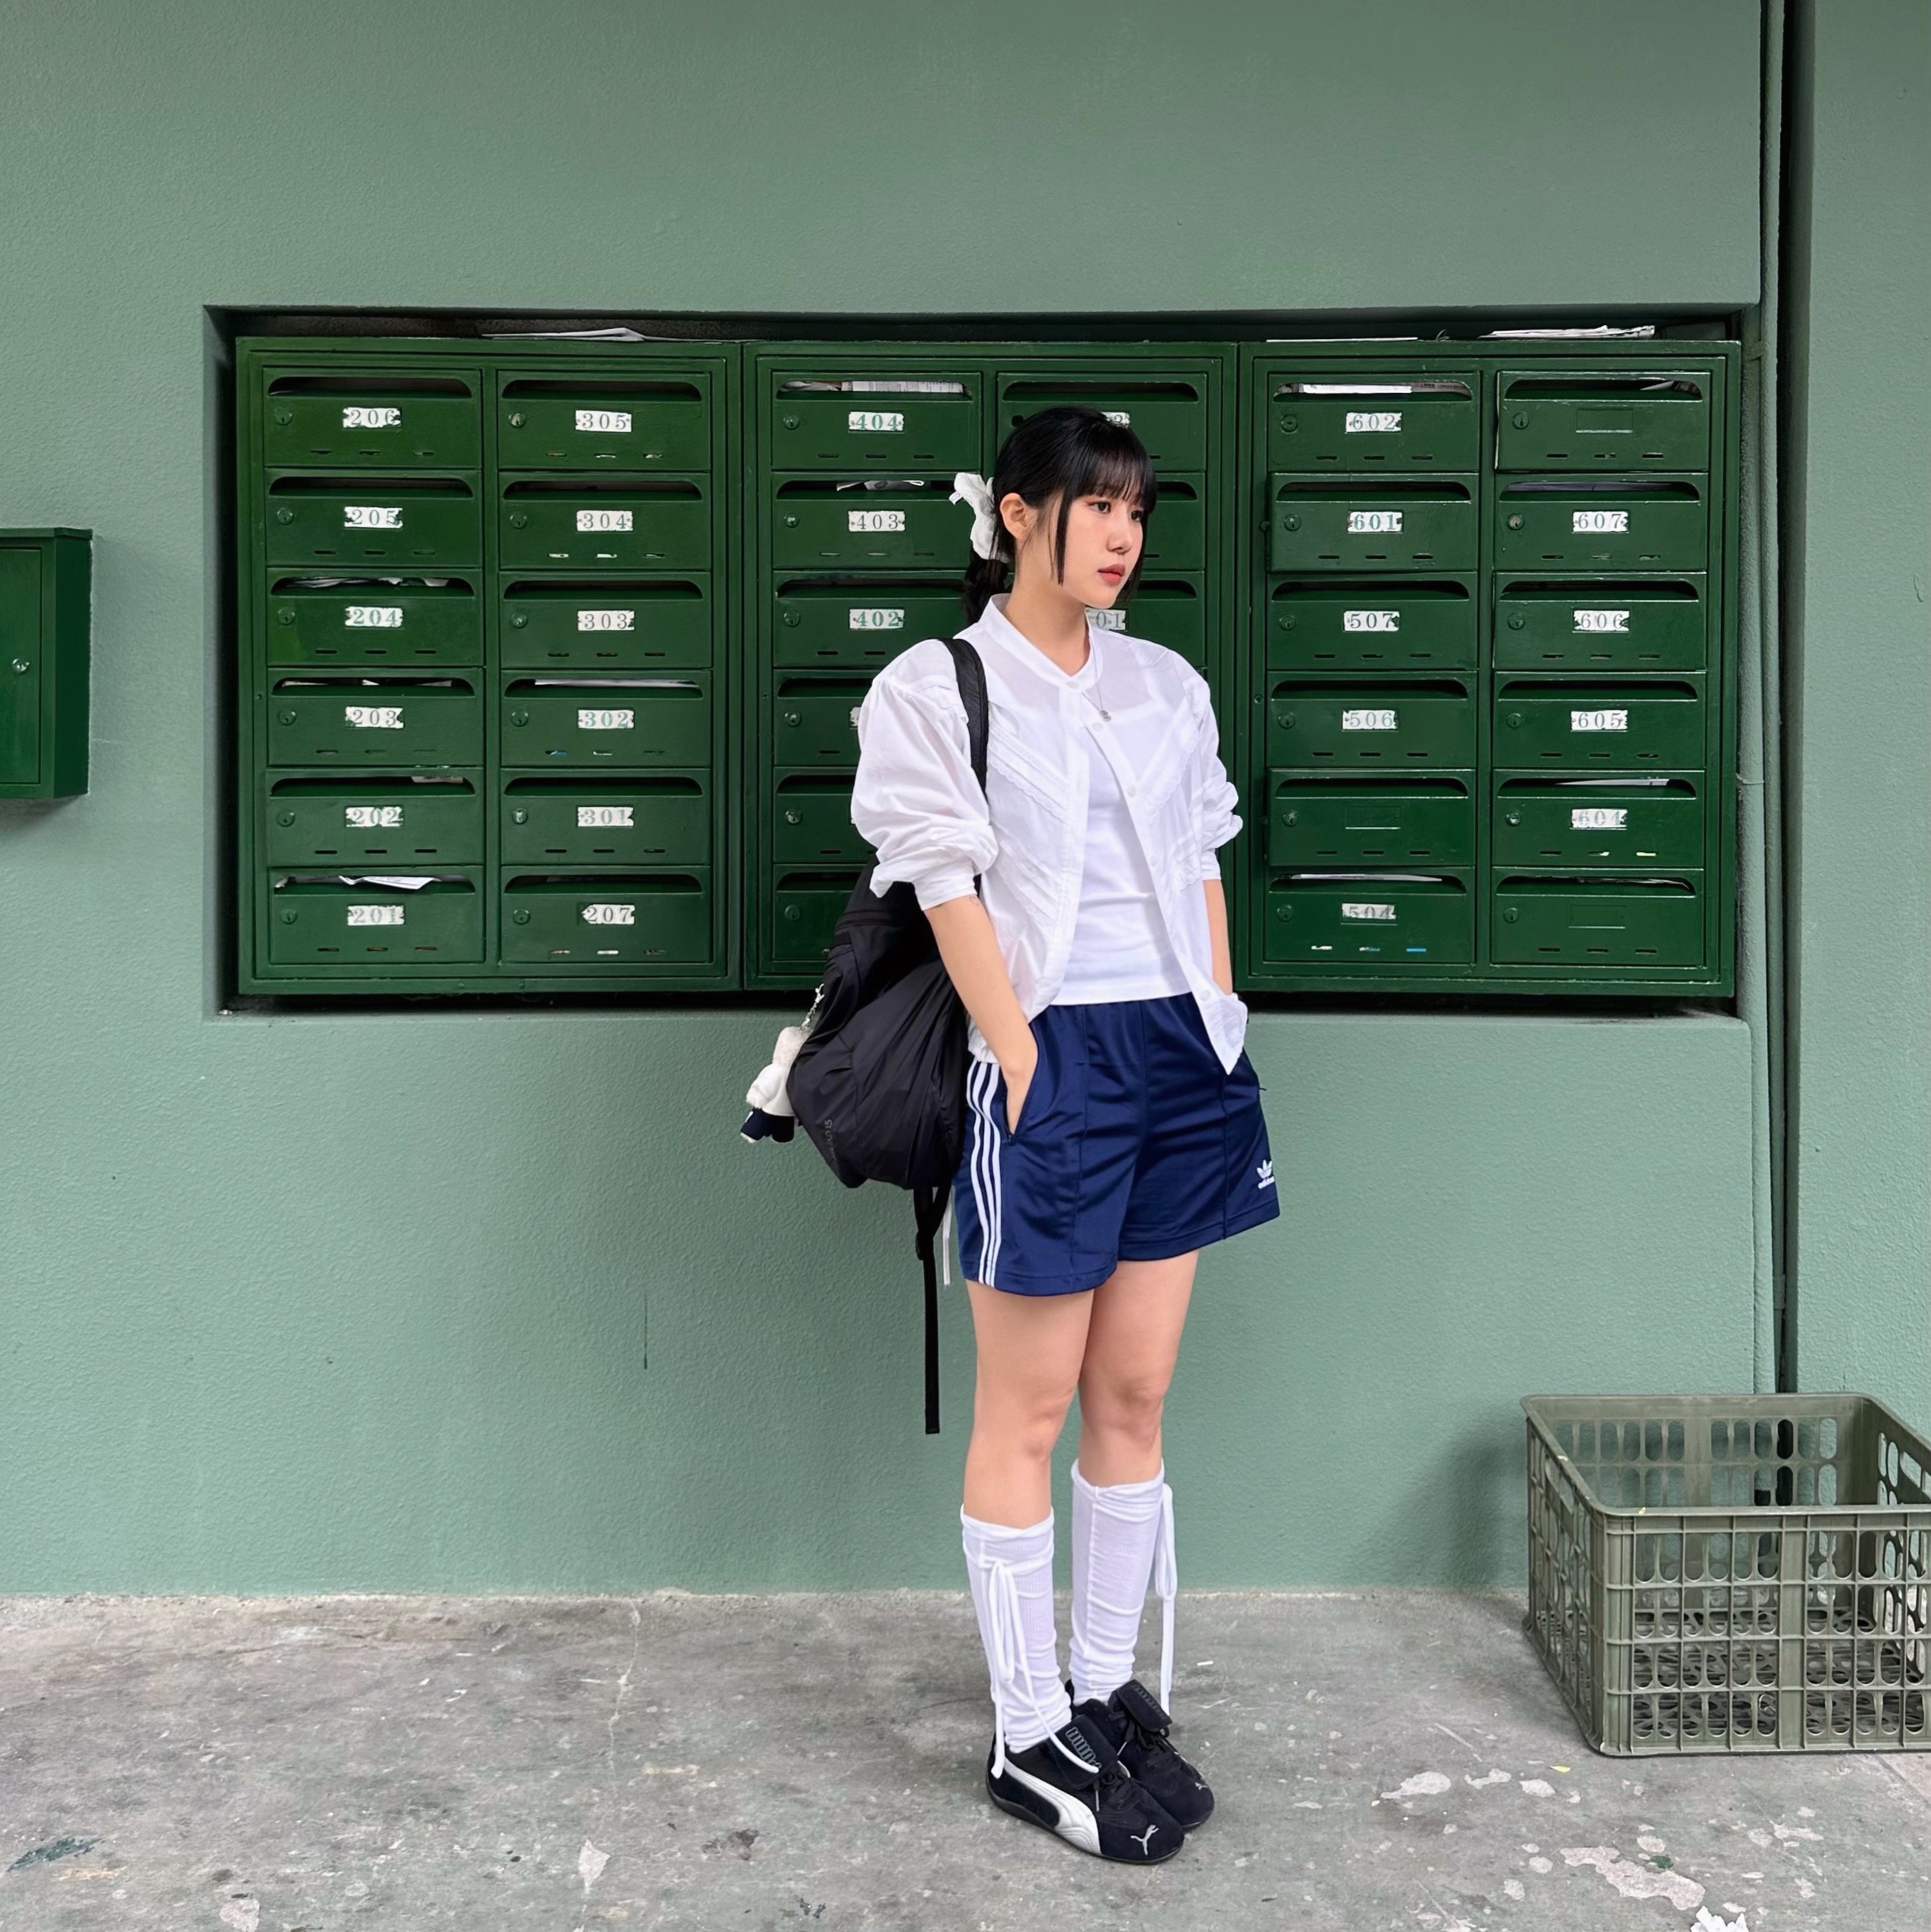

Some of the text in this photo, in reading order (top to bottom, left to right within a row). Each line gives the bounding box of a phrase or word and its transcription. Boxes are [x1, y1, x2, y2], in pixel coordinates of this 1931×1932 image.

[351, 410, 394, 425] 206
[582, 413, 627, 430] 305
[856, 414, 898, 431] 404
[1352, 414, 1396, 430] 602
[352, 509, 397, 525] 205
[584, 513, 627, 529] 304
[856, 514, 899, 530] 403
[1354, 514, 1397, 530] 601
[1578, 513, 1621, 529] 607
[352, 609, 398, 625] 204
[584, 613, 626, 629] 303
[856, 611, 899, 627] 402
[1086, 611, 1121, 629] 01
[1350, 613, 1393, 629] 507
[1580, 614, 1622, 629] 606
[353, 709, 397, 726] 203
[585, 711, 629, 728] 302
[1349, 713, 1393, 728] 506
[1578, 712, 1622, 728] 605
[353, 809, 398, 824] 202
[584, 809, 626, 824] 301
[353, 908, 396, 924] 201
[587, 907, 631, 922] 207
